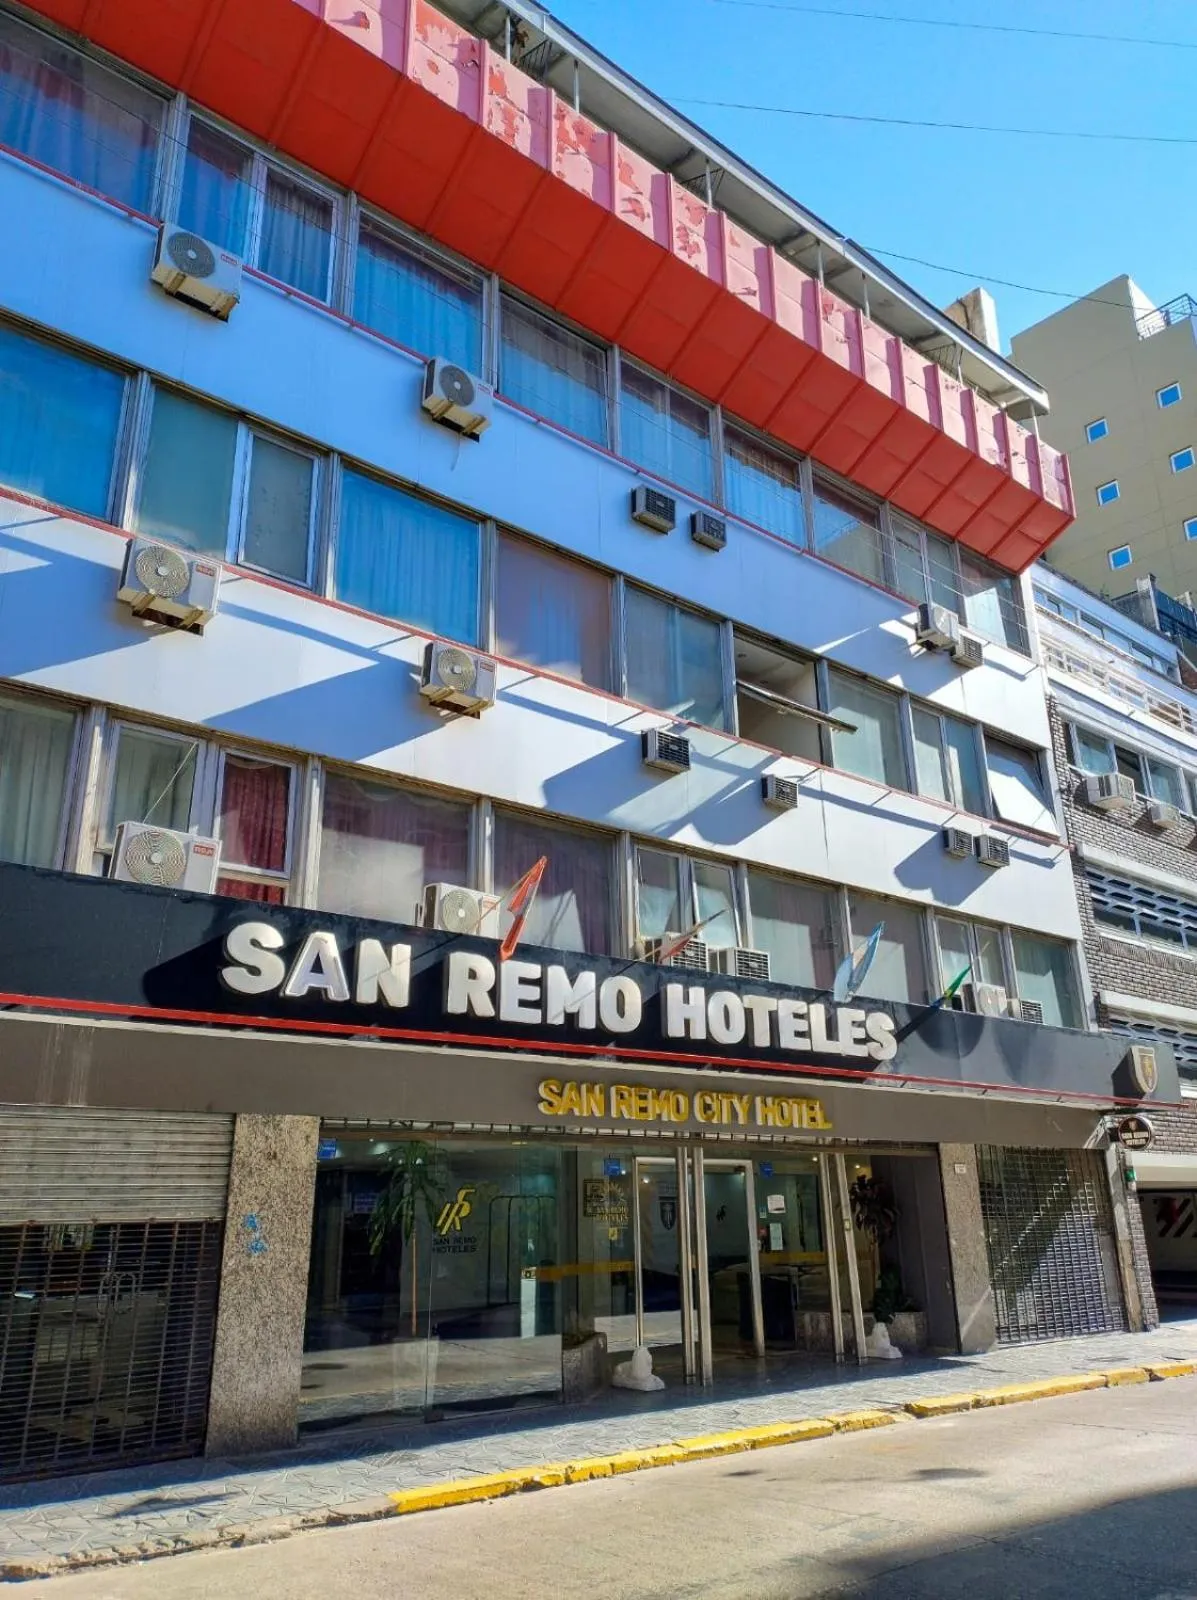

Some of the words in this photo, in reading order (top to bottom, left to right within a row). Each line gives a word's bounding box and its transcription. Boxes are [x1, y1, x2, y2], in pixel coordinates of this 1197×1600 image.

[219, 921, 412, 1008] SAN
[445, 951, 643, 1034] REMO
[663, 982, 898, 1061] HOTELES
[538, 1079, 605, 1117] SAN
[610, 1085, 690, 1124] REMO
[693, 1090, 750, 1125] CITY
[755, 1096, 833, 1130] HOTEL
